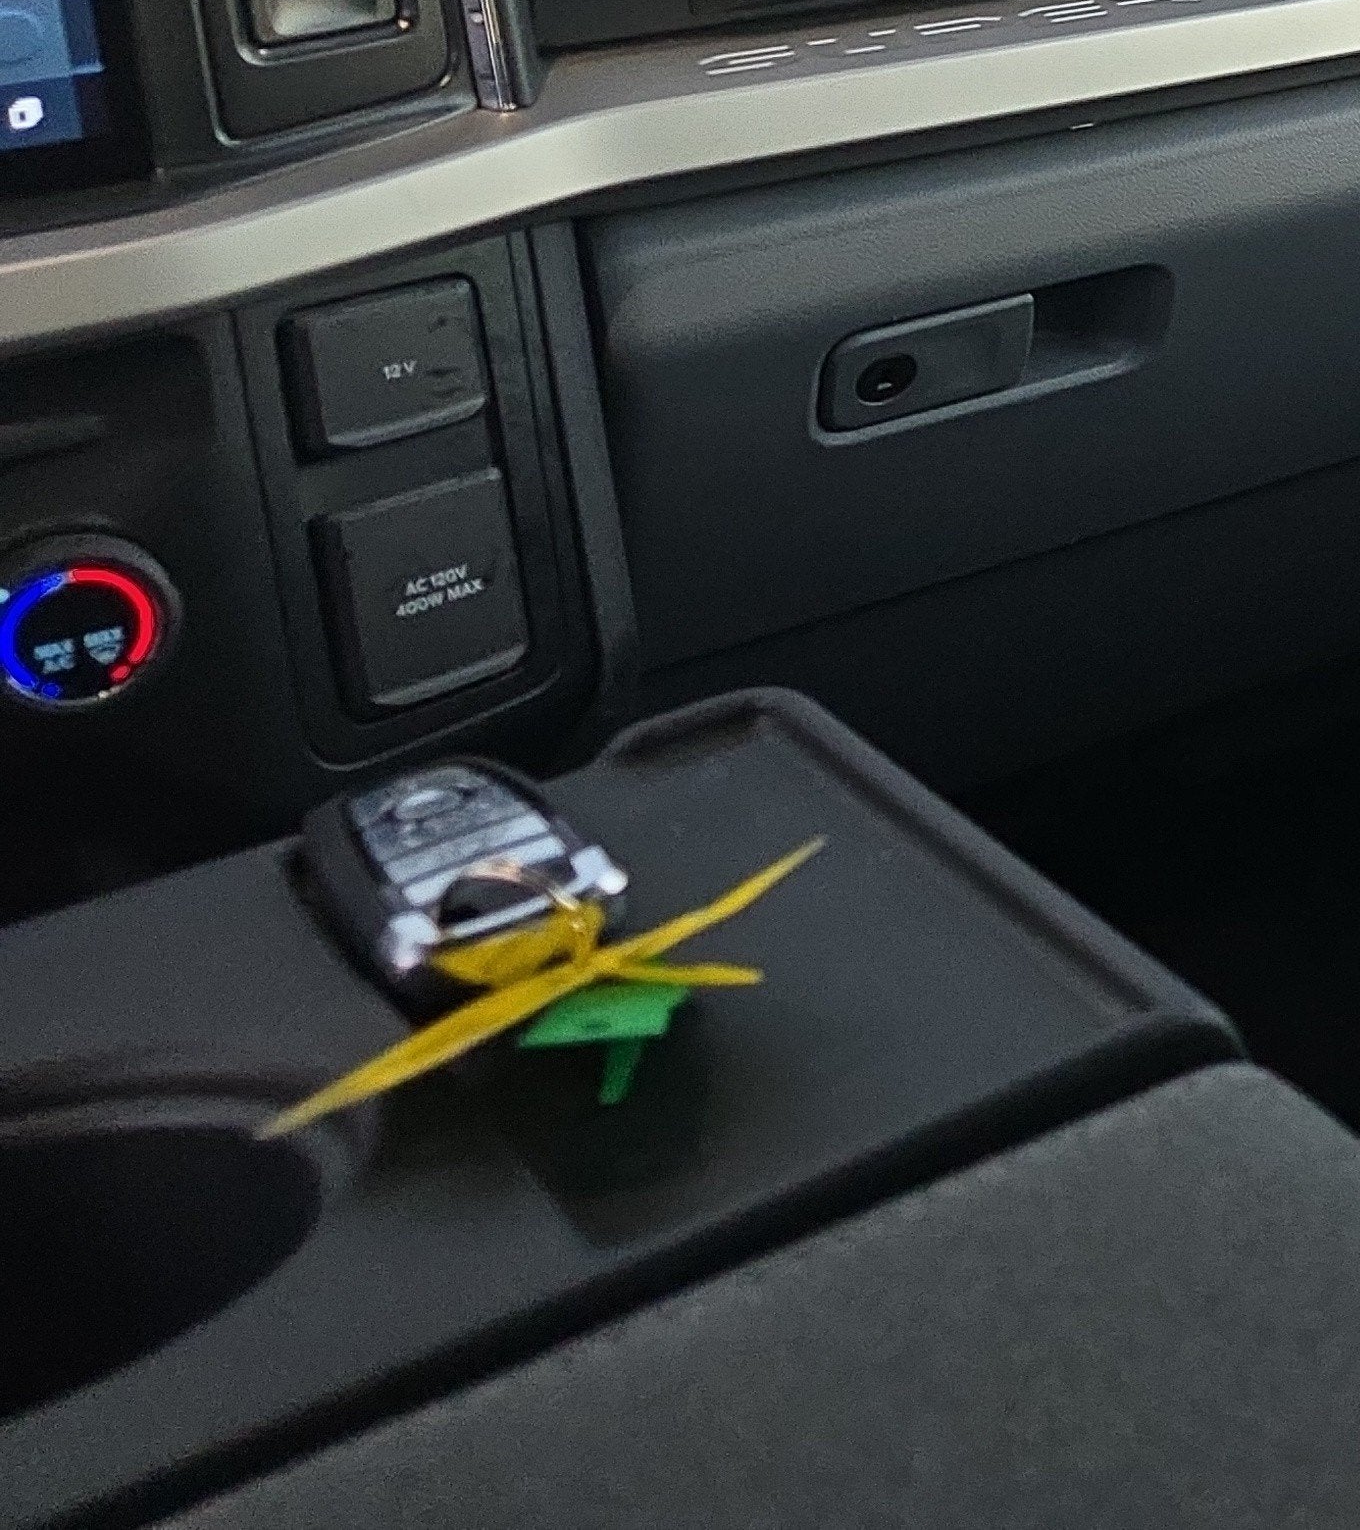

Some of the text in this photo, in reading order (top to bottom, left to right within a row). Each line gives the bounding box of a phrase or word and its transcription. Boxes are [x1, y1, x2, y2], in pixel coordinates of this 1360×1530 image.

[396, 578, 484, 617] 400W MAX
[405, 563, 468, 597] AC 120V
